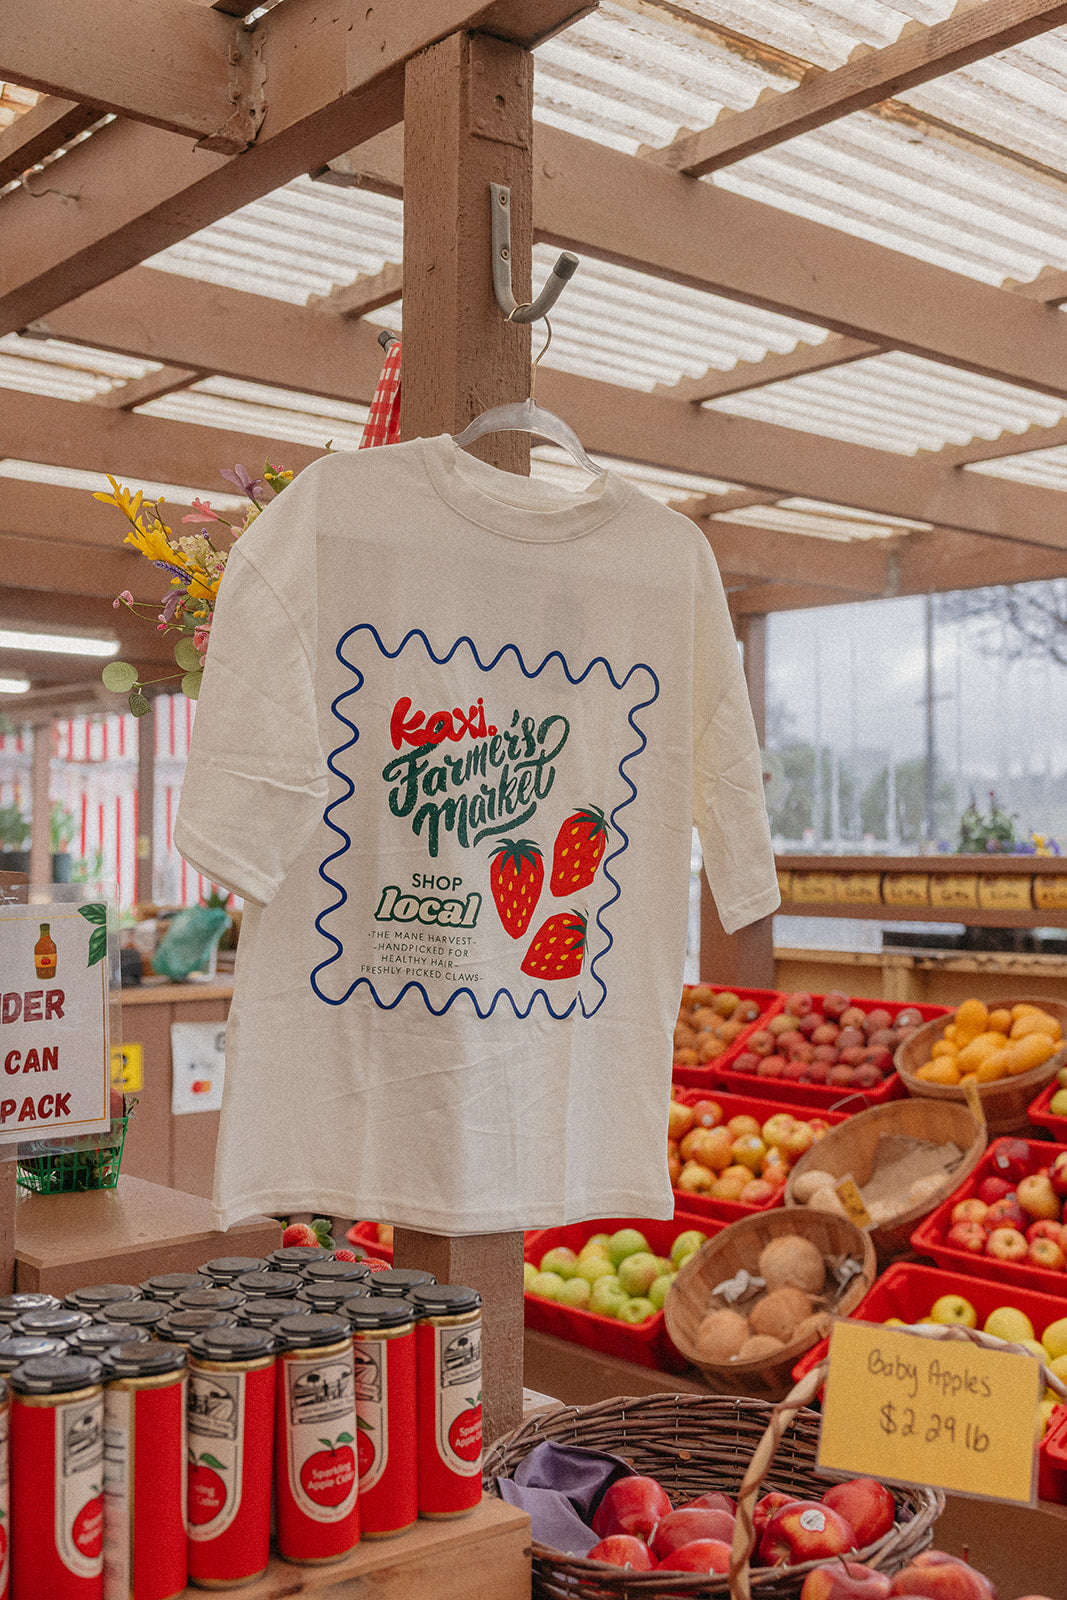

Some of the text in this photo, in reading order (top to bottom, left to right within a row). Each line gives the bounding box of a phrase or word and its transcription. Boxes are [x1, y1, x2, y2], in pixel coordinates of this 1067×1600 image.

[382, 709, 571, 817] Farmer's
[411, 872, 463, 892] SHOP
[374, 885, 482, 929] local
[395, 931, 424, 941] MANE
[381, 955, 427, 965] HEALTHY
[448, 949, 469, 958] FOR
[361, 964, 402, 975] FRESHLY
[405, 967, 442, 979] PICKED
[4, 1046, 60, 1075] CAN
[0, 1091, 72, 1124] PACK
[867, 1348, 992, 1398] Baby Apples
